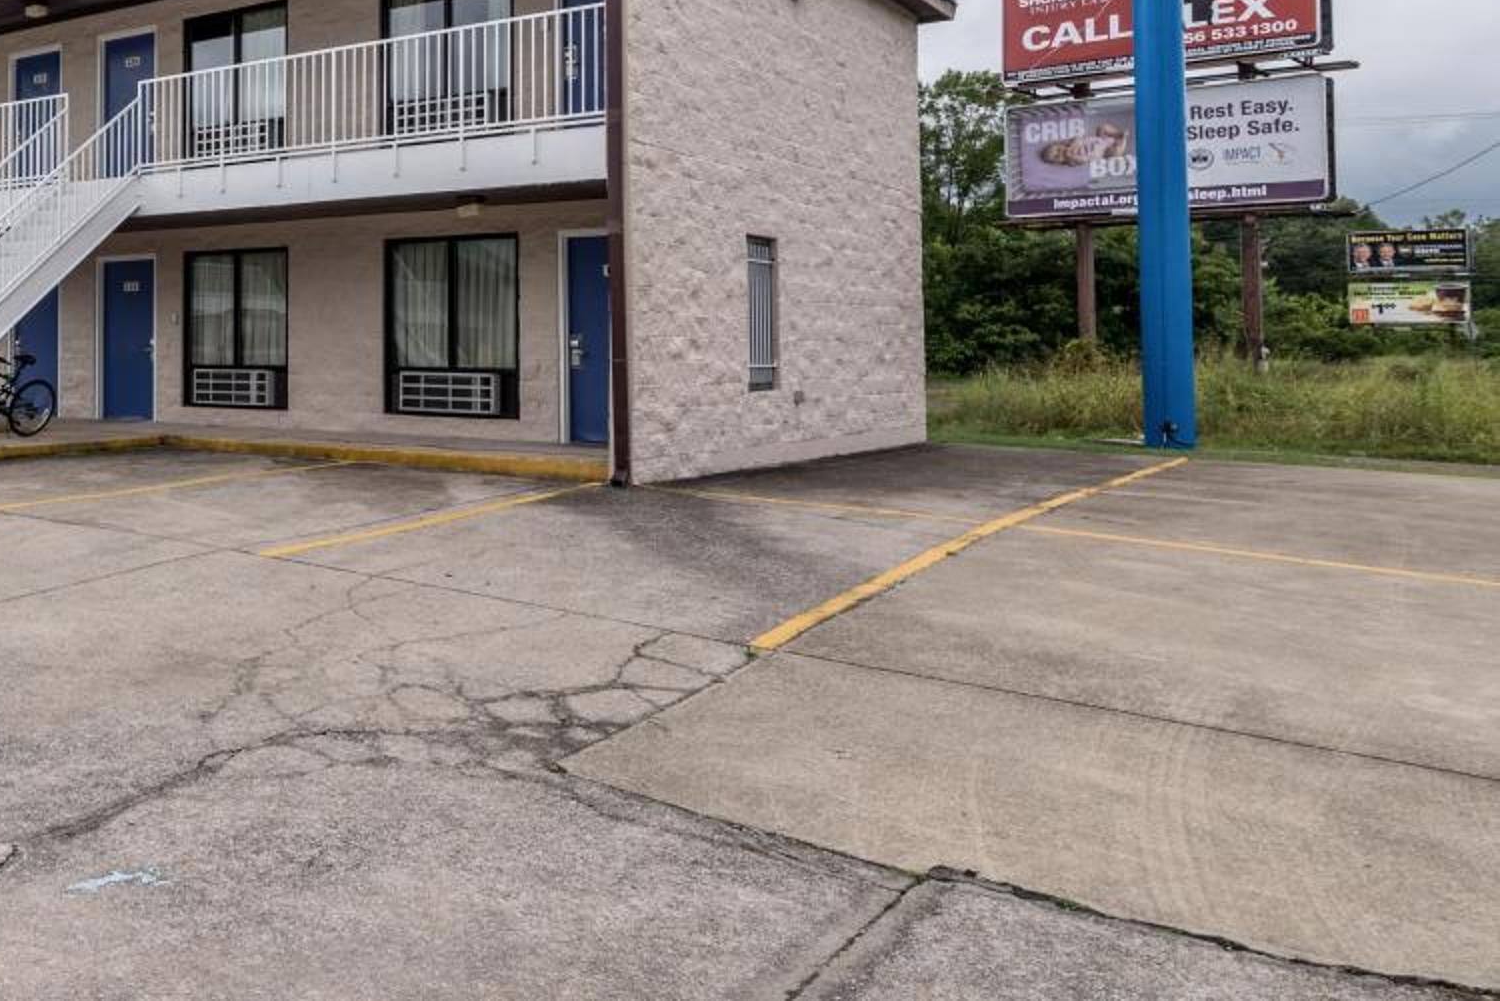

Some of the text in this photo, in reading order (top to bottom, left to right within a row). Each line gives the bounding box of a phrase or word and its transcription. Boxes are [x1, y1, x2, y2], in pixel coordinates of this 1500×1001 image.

[1021, 14, 1135, 52] CALL
[1183, 18, 1298, 44] 56 533 1300
[1190, 99, 1294, 121] Rest Easy.
[1025, 118, 1085, 144] CRIB
[1187, 118, 1300, 140] Sleep Safe.
